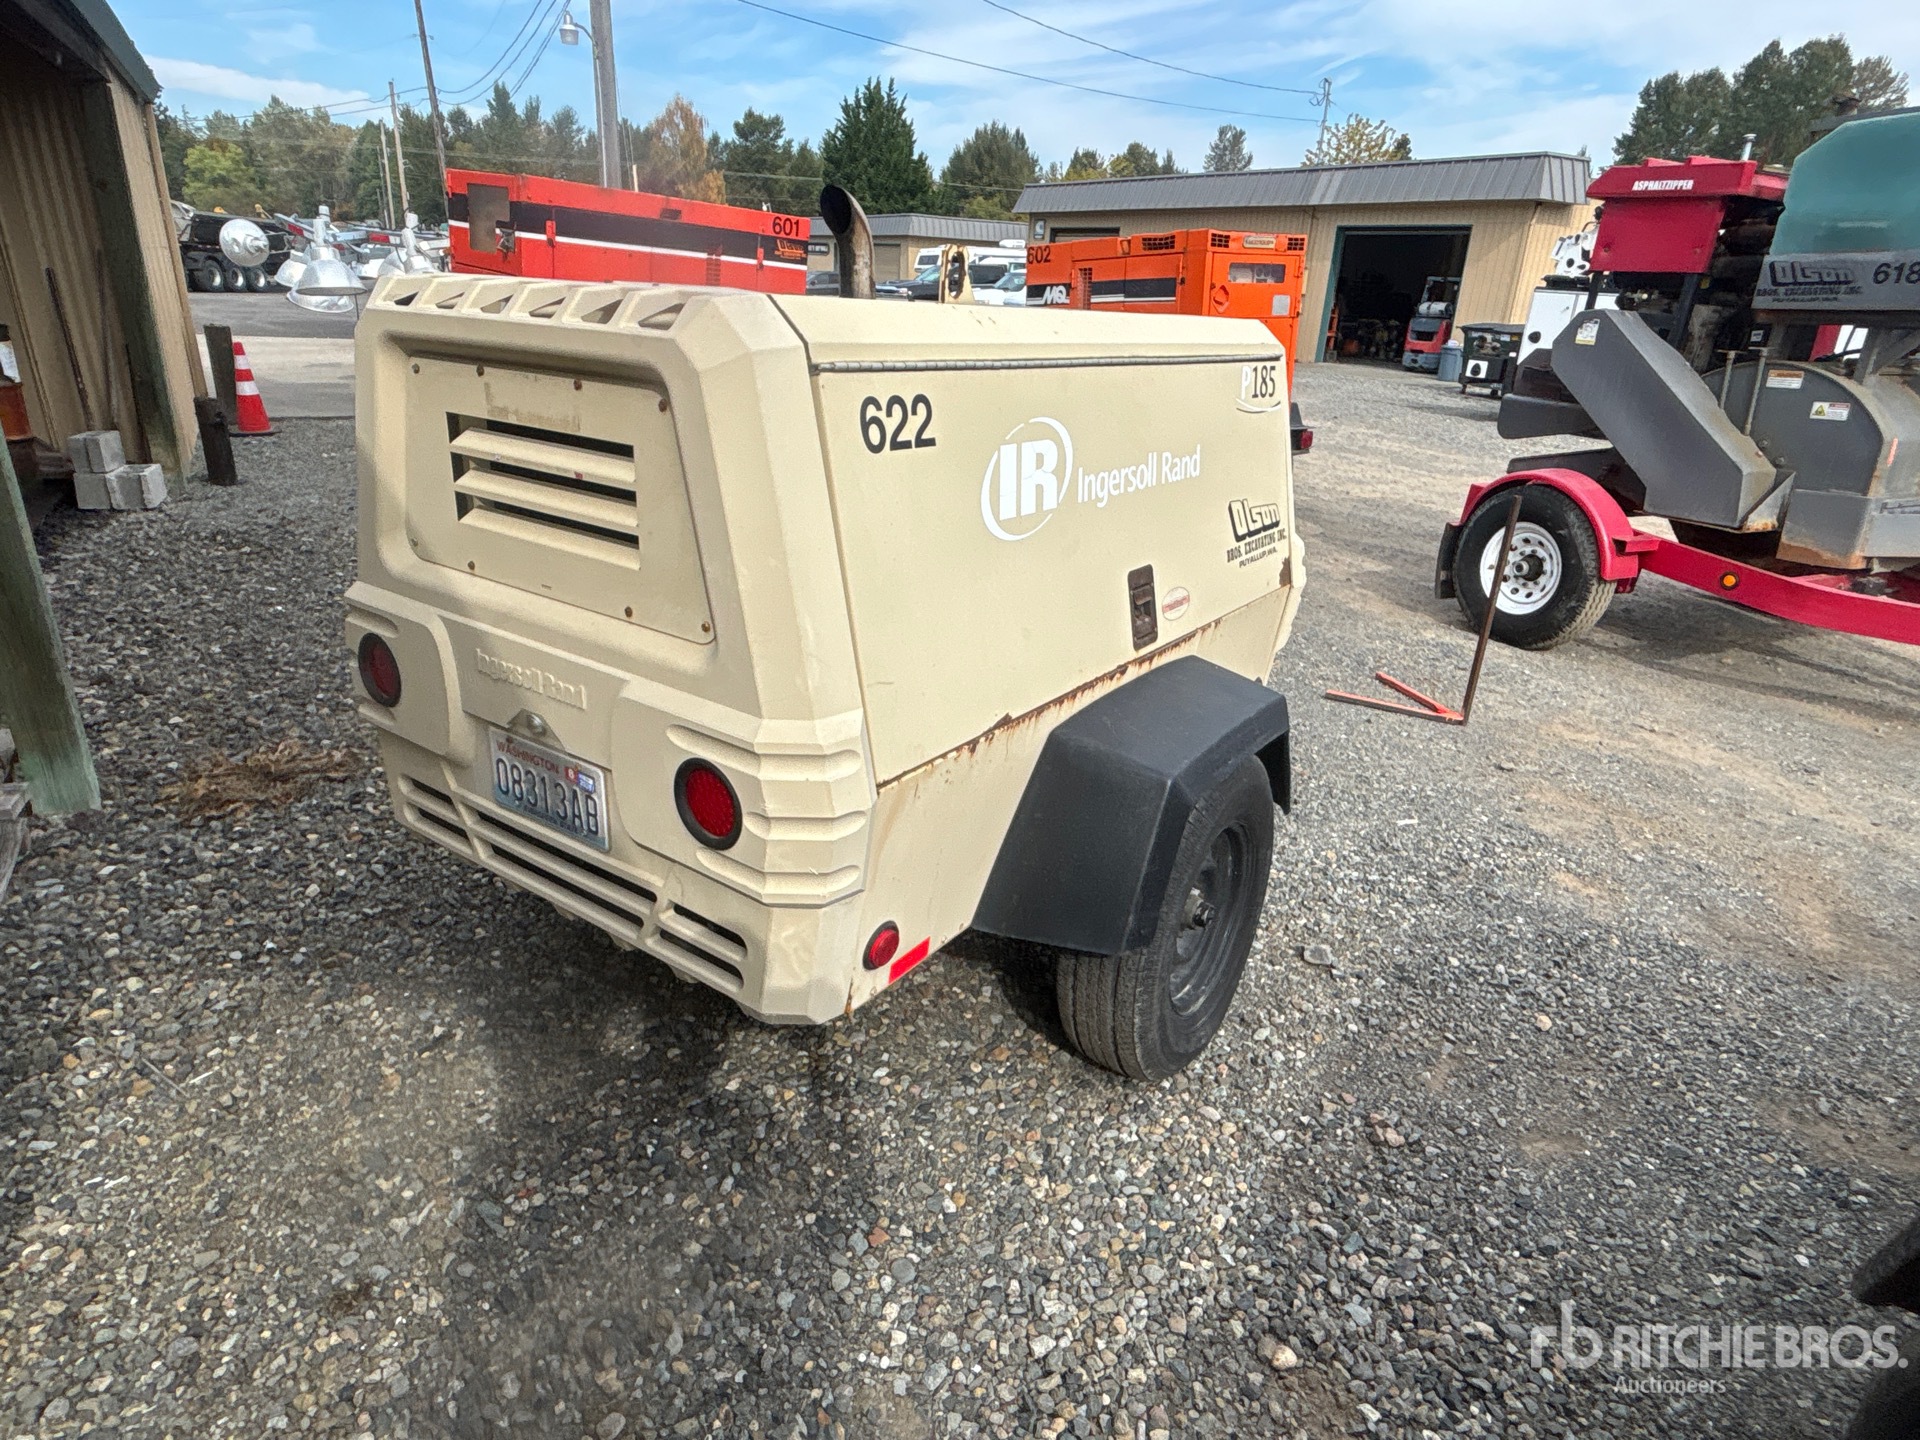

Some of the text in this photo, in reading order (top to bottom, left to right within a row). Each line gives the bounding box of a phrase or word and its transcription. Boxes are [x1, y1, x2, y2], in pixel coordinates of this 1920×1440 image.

[772, 216, 800, 237] 601
[1027, 245, 1051, 265] 602
[1873, 261, 1920, 285] 618
[859, 393, 937, 454] 622
[999, 438, 1058, 522] IR
[1077, 443, 1201, 508] Ingersoll Rand
[1228, 498, 1281, 543] Olson
[496, 741, 561, 775] WASHINGTON
[496, 757, 600, 836] 08313AB
